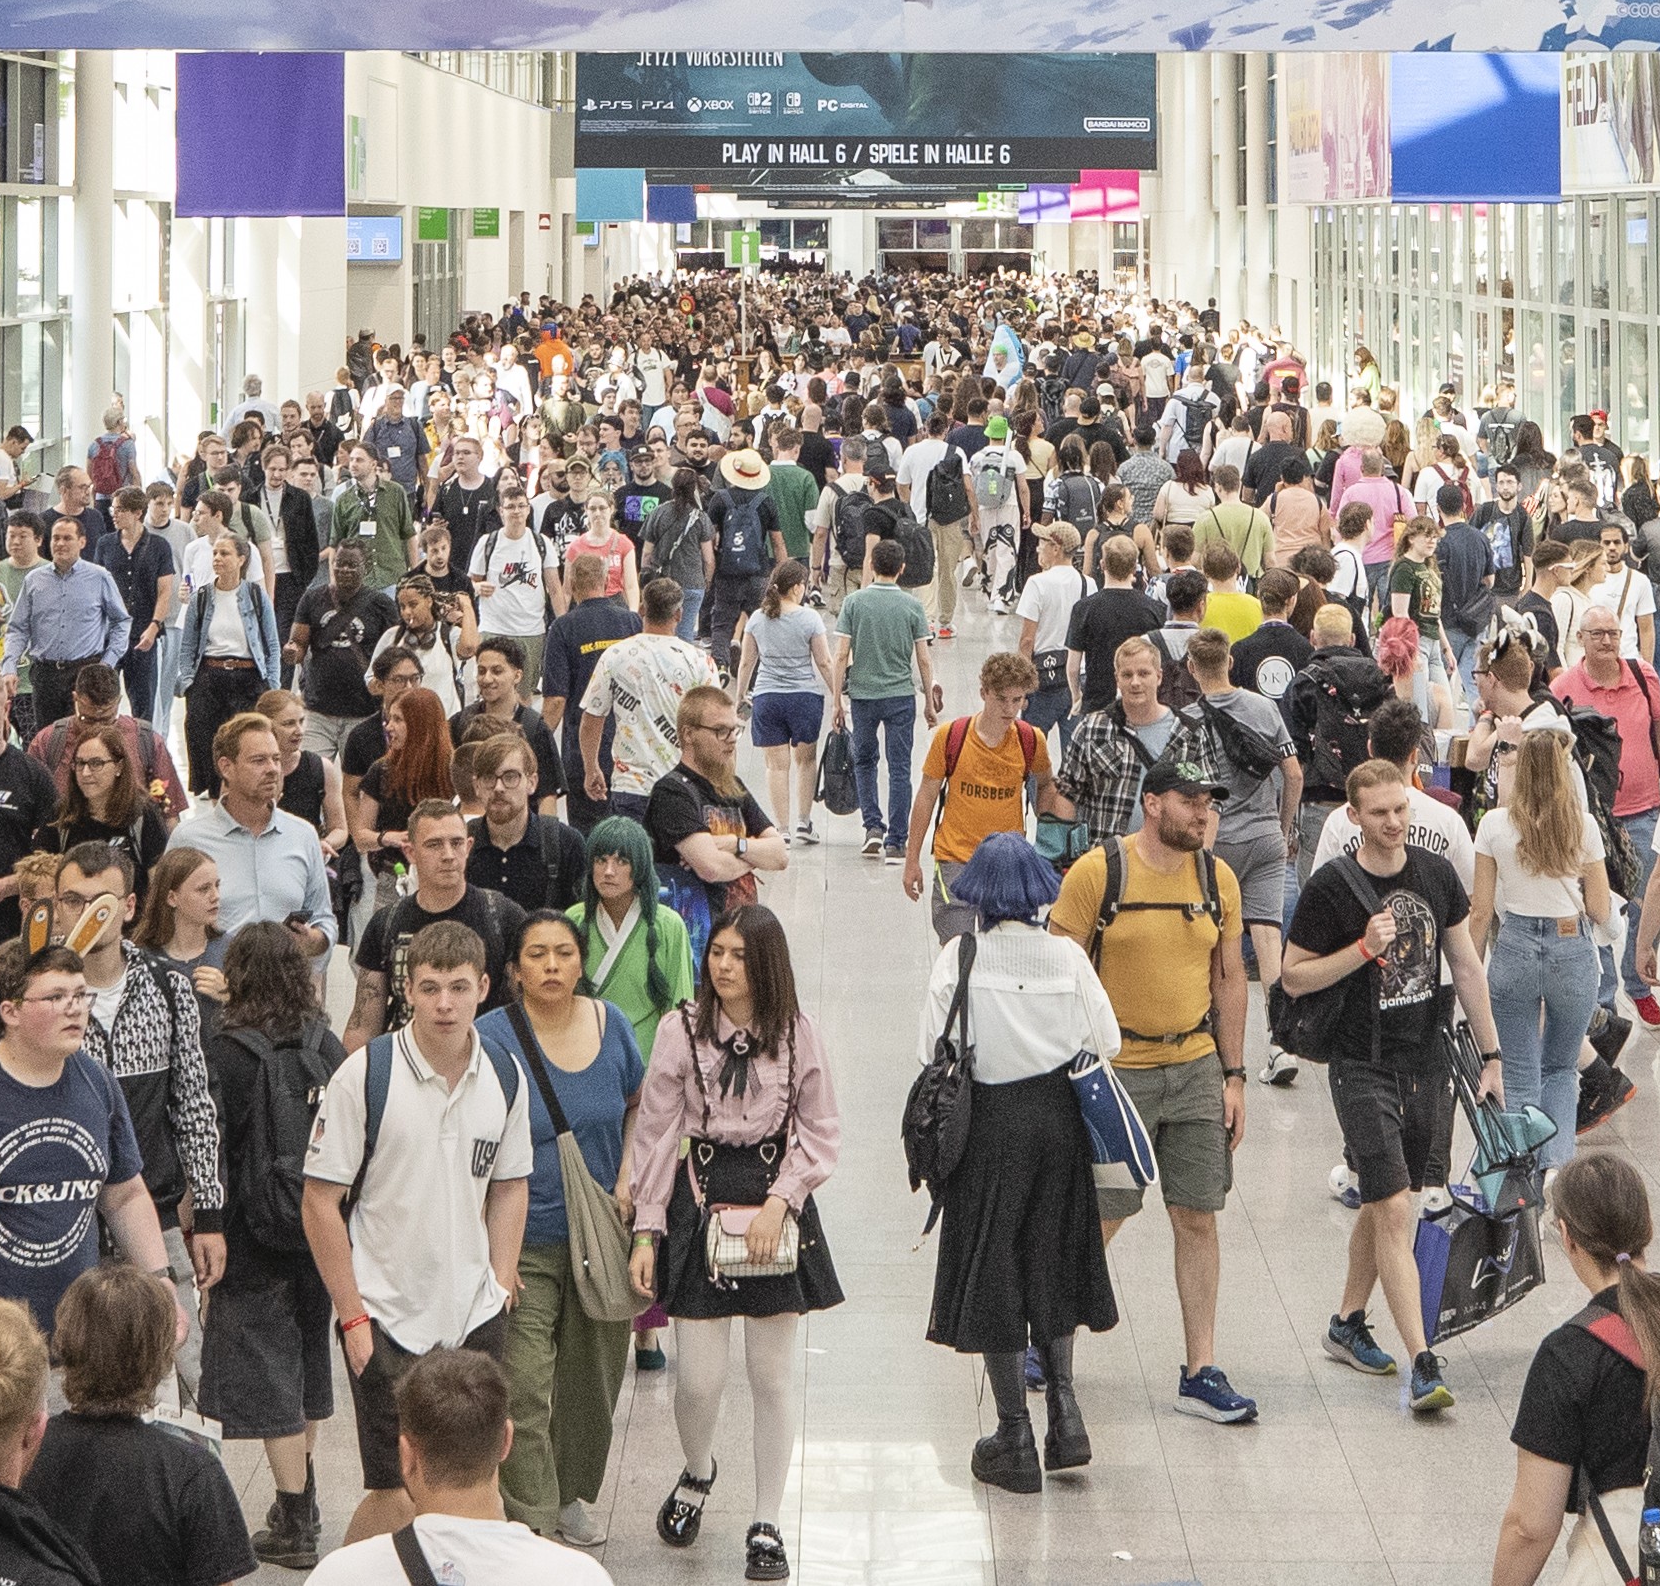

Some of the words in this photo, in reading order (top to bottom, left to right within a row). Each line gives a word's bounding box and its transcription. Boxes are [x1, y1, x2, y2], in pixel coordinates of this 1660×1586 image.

[599, 100, 633, 110] PS5
[642, 100, 675, 110] PS4
[703, 100, 734, 110] XBOX
[817, 99, 838, 112] PC
[723, 143, 761, 163] PLAY
[768, 143, 783, 163] IN
[790, 143, 829, 163] HALL
[836, 143, 846, 163] 6
[869, 144, 918, 164] SPIELE
[925, 144, 940, 164] IN
[946, 145, 994, 164] HALLE
[999, 145, 1011, 164] 6
[961, 782, 1016, 800] FORSBERG
